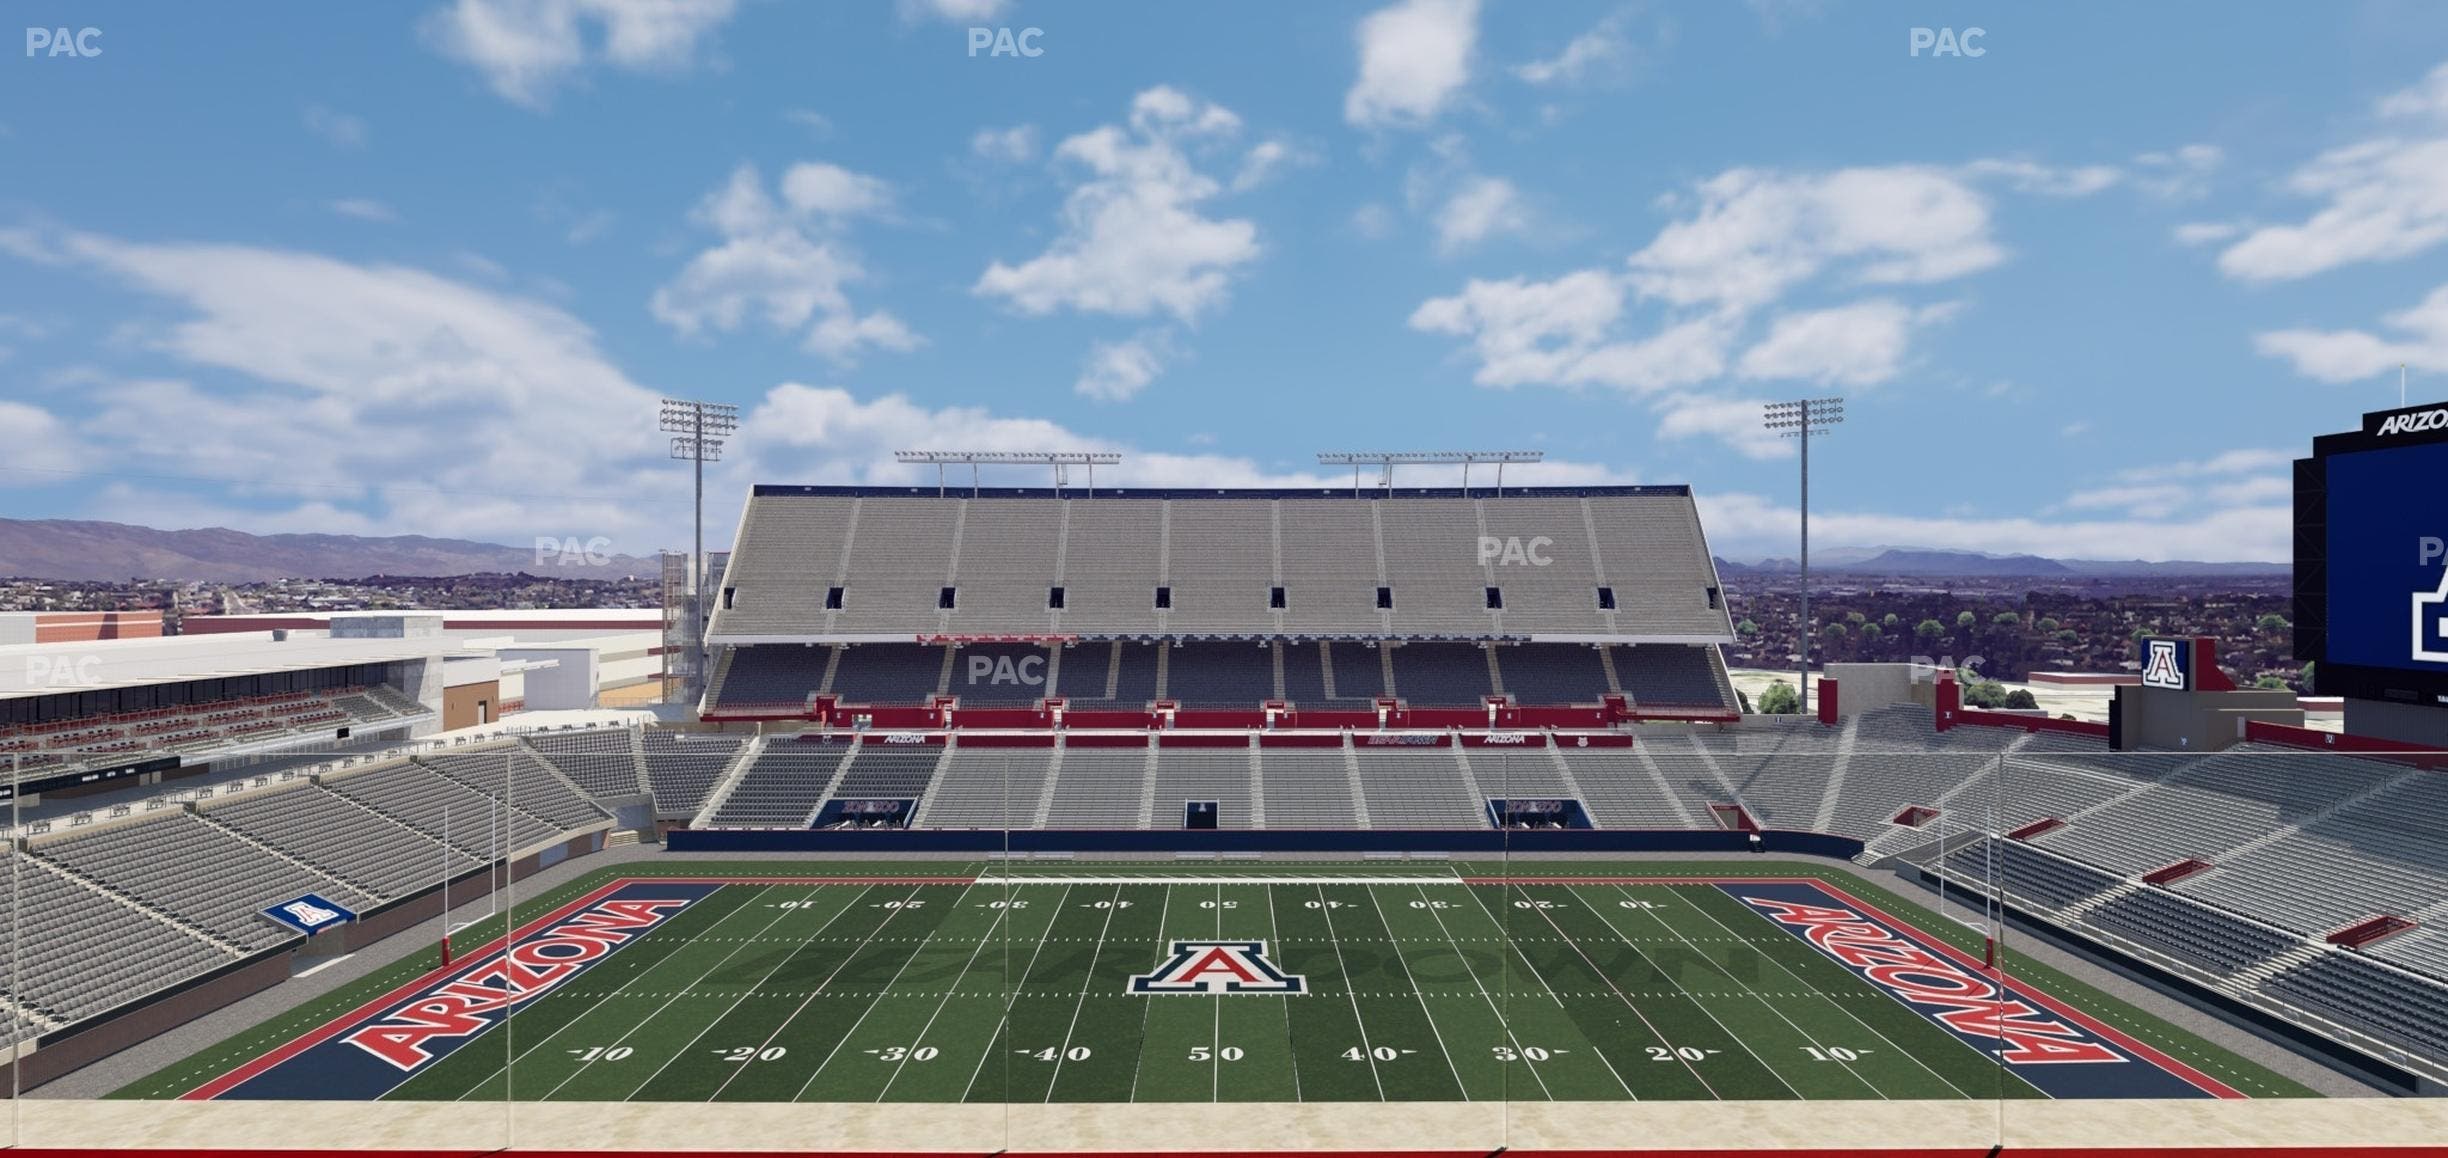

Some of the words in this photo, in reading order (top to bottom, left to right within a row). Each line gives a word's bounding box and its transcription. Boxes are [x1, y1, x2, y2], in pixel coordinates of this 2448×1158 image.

[2376, 408, 2448, 437] ARIZO
[2143, 640, 2184, 690] A
[884, 735, 925, 744] ARIZONA
[1484, 735, 1525, 744] ARIZONA
[283, 901, 339, 926] A
[1126, 940, 1309, 994] A
[338, 899, 691, 1071] ARIZONA
[1741, 897, 2130, 1064] ARIZONA
[573, 1046, 634, 1062] 10
[723, 1046, 788, 1062] 20
[877, 1046, 939, 1062] 30
[1033, 1046, 1092, 1062] 40
[1188, 1046, 1245, 1062] 50
[1341, 1046, 1398, 1062] 40
[1491, 1046, 1550, 1062] 30
[1644, 1046, 1705, 1062] 20
[1799, 1046, 1859, 1062] 10
